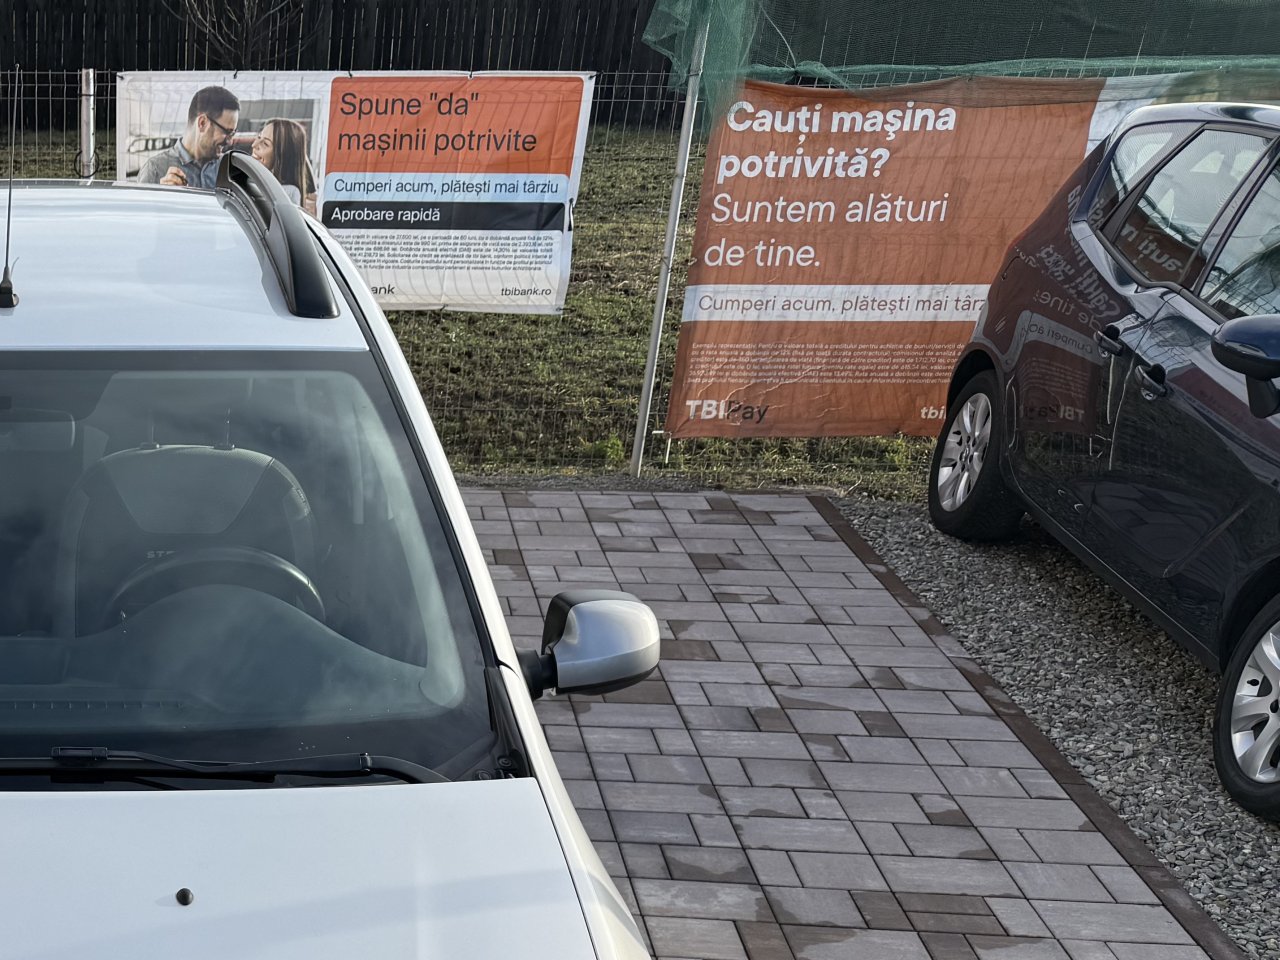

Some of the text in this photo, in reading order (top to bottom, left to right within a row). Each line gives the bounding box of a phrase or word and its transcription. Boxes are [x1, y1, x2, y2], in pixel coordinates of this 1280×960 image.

[340, 92, 479, 120] Spune "da"
[727, 101, 823, 145] Cauți
[337, 128, 537, 156] mașinii potrivite
[717, 147, 891, 184] potrivită?
[334, 179, 559, 196] Cumperi acum, plătești mai târziu
[331, 207, 440, 224] Aprobare rapidă
[711, 192, 950, 223] Suntem alături
[704, 238, 821, 267] de tine.
[371, 284, 395, 295] ank
[501, 287, 552, 297] tbibank.ro
[698, 295, 776, 315] Cumperi
[781, 297, 836, 312] acum,
[916, 295, 948, 311] mai
[954, 295, 986, 311] târz
